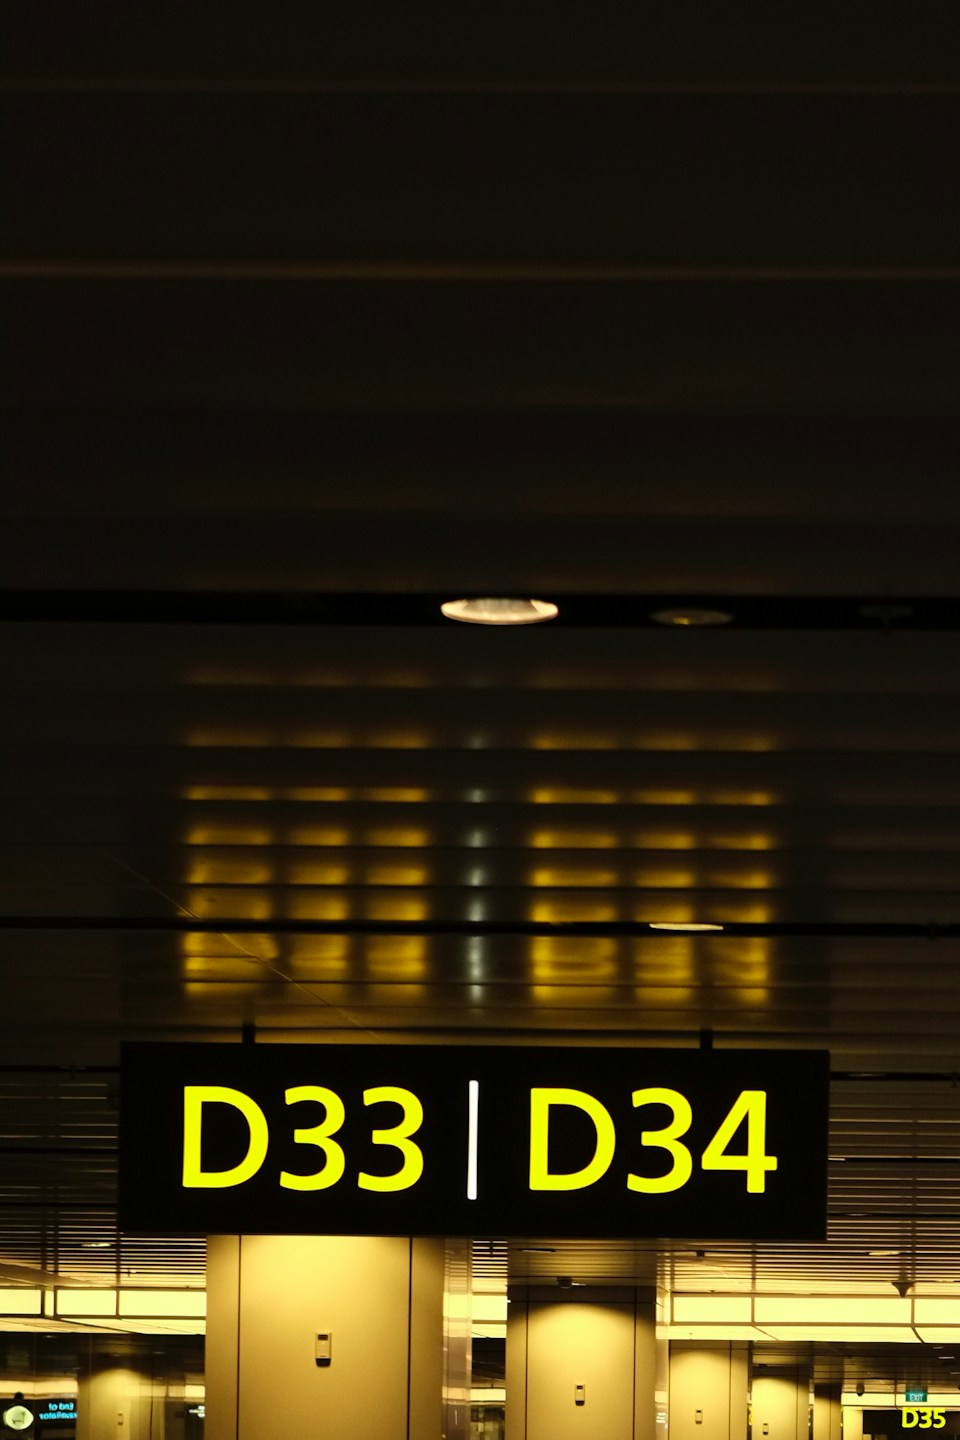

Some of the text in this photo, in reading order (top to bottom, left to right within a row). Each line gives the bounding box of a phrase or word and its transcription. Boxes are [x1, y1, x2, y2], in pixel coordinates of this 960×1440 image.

[182, 1085, 424, 1192] D33
[529, 1087, 778, 1194] D34
[901, 1407, 946, 1428] D35
[910, 1393, 924, 1402] EXIT
